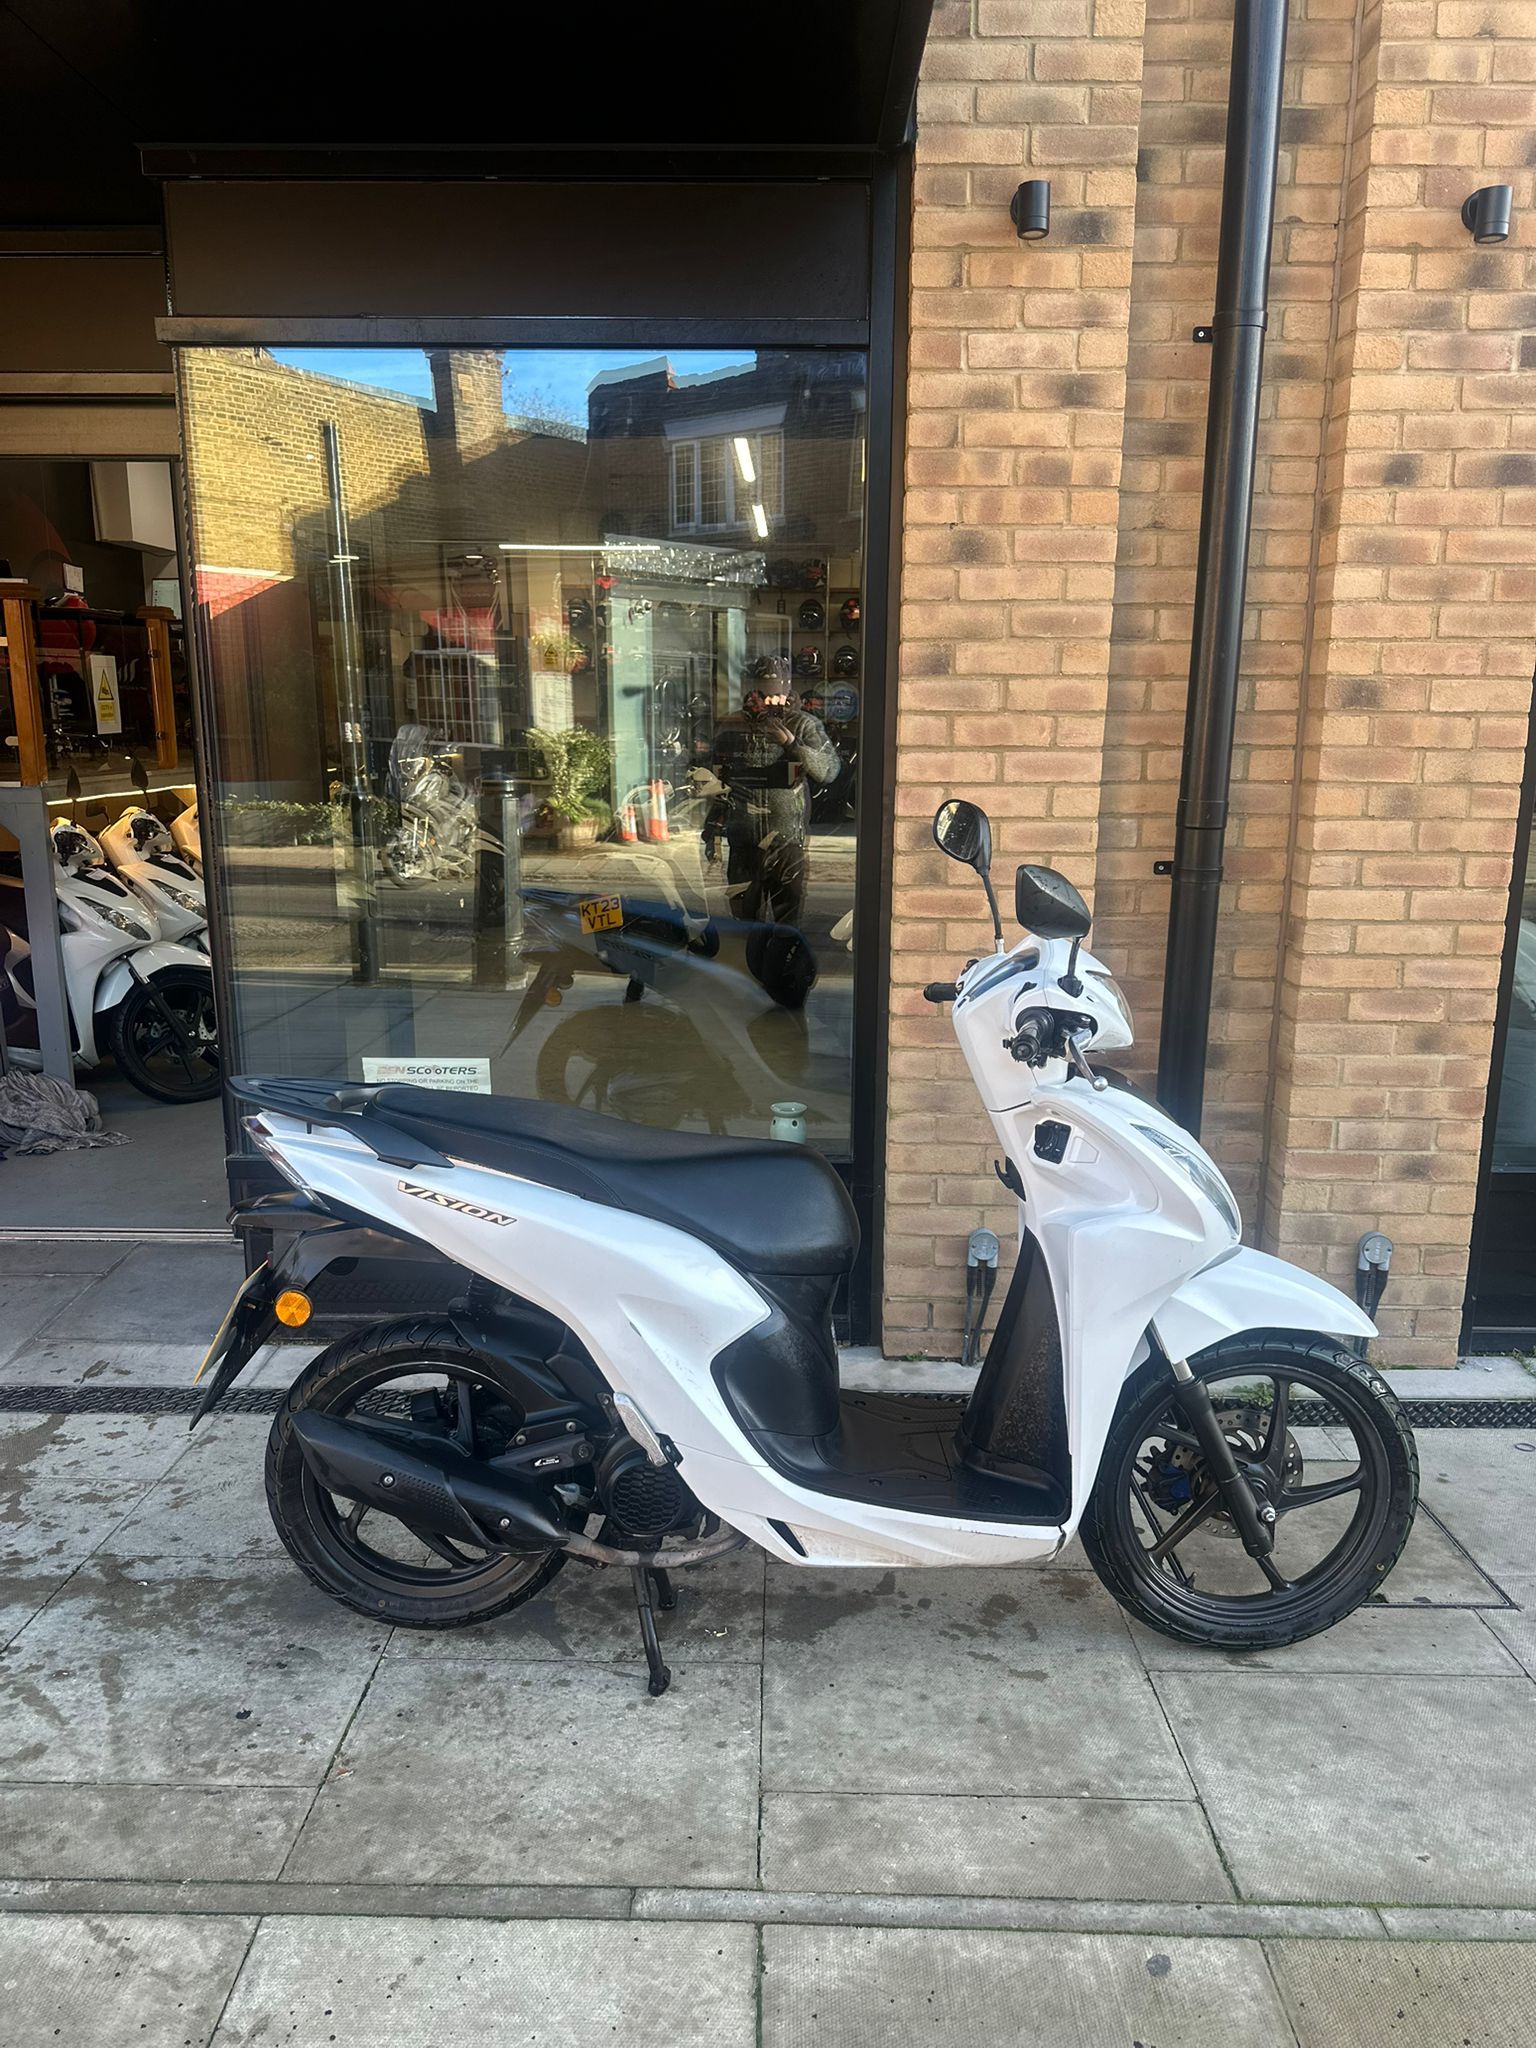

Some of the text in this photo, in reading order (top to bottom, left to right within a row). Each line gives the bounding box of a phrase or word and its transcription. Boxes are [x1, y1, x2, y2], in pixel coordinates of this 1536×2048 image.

[581, 897, 620, 917] KT23
[588, 913, 617, 929] VTL
[399, 1181, 515, 1226] VISION
